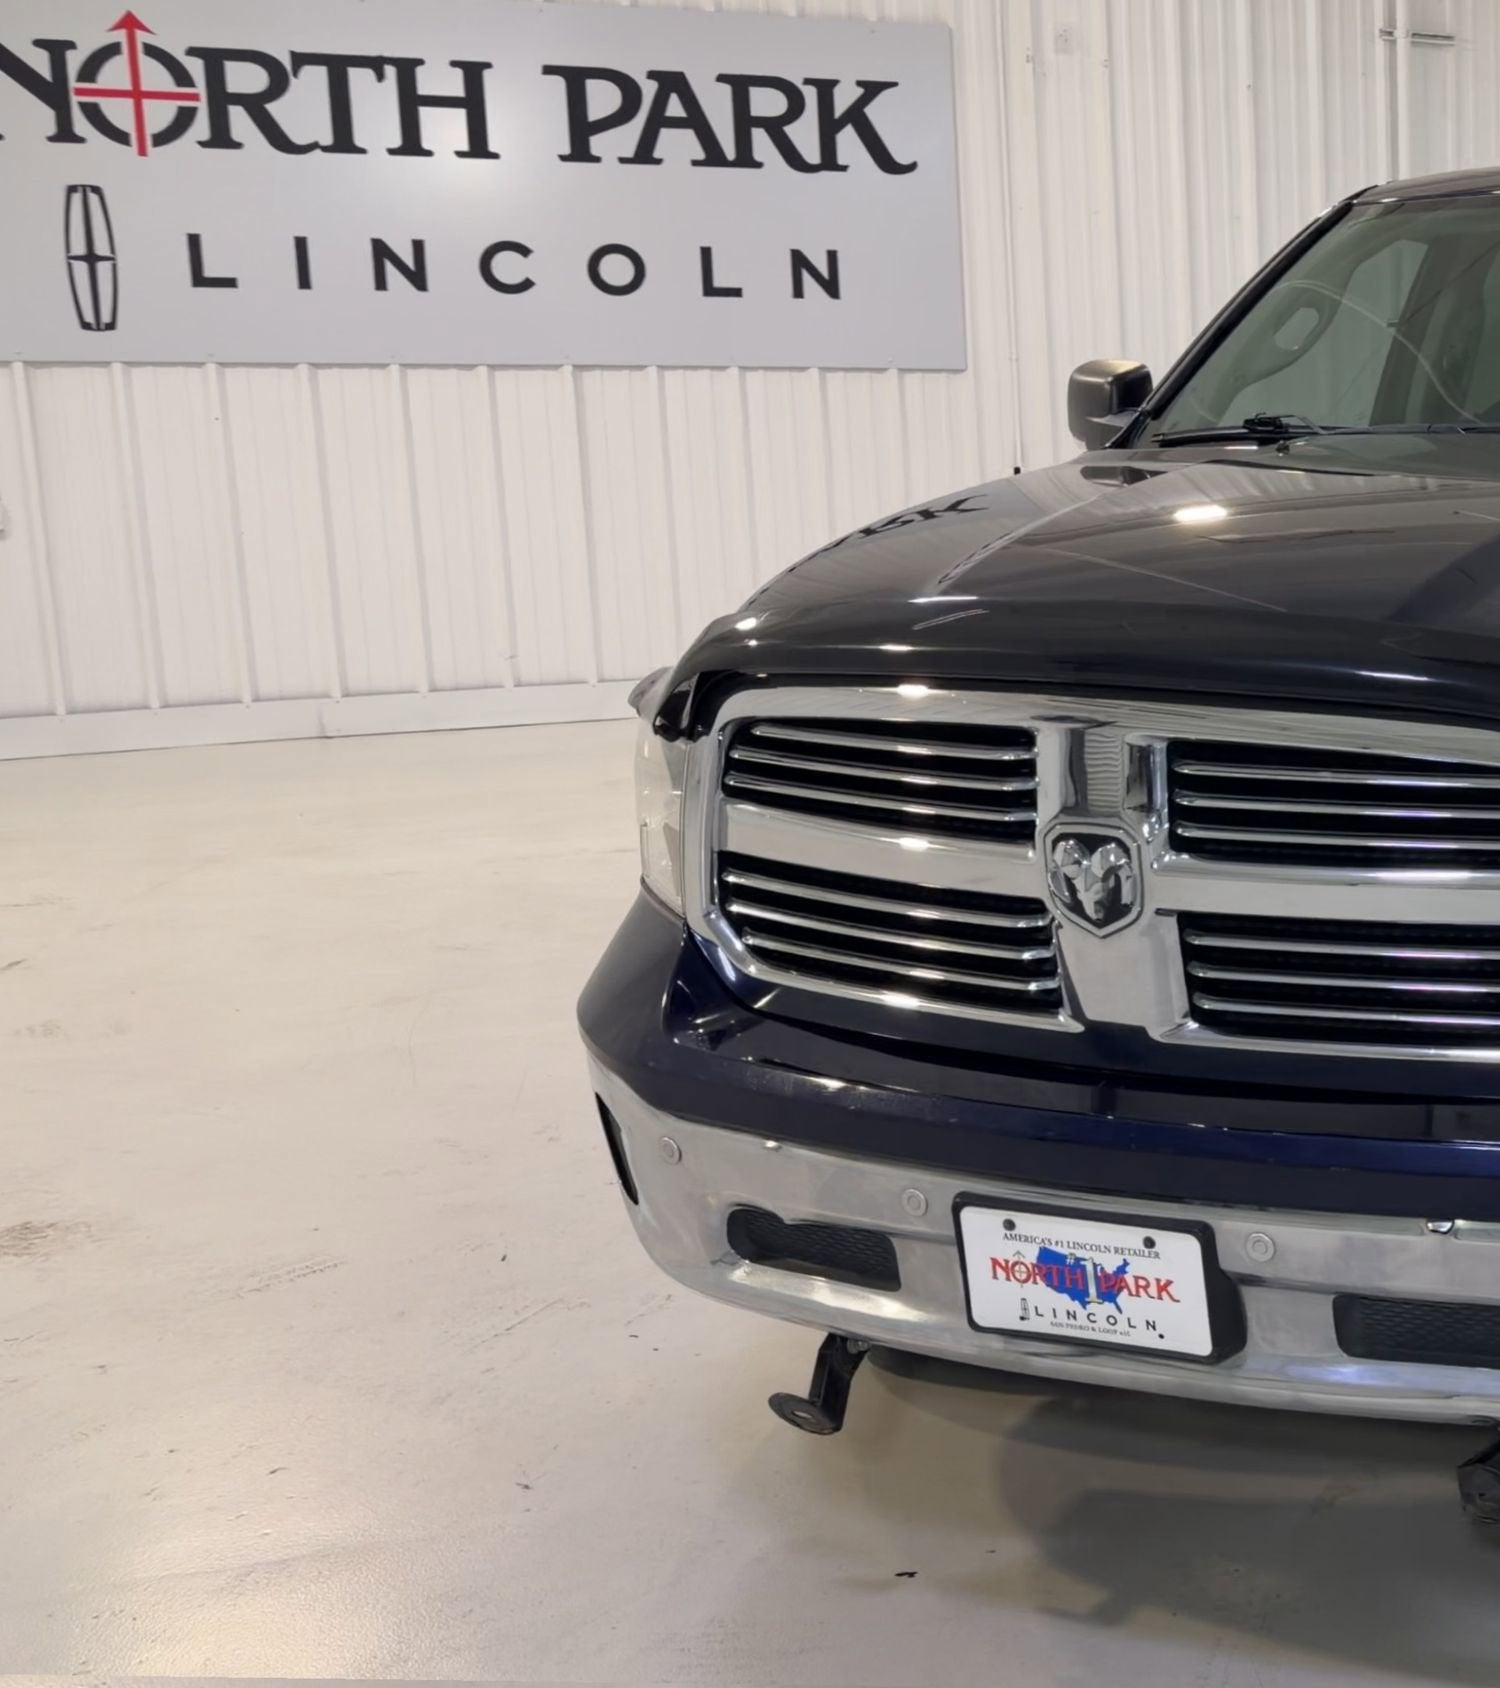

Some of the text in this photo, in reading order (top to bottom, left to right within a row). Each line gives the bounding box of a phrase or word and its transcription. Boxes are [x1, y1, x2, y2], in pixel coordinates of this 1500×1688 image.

[0, 38, 918, 175] NORTH PARK
[185, 232, 842, 300] LINCOLN
[1002, 1232, 1161, 1260] AMERICA'S #1 LINCOLN RETAILER
[989, 1256, 1181, 1303] NORTH PARK
[1034, 1305, 1157, 1331] LINCOLN
